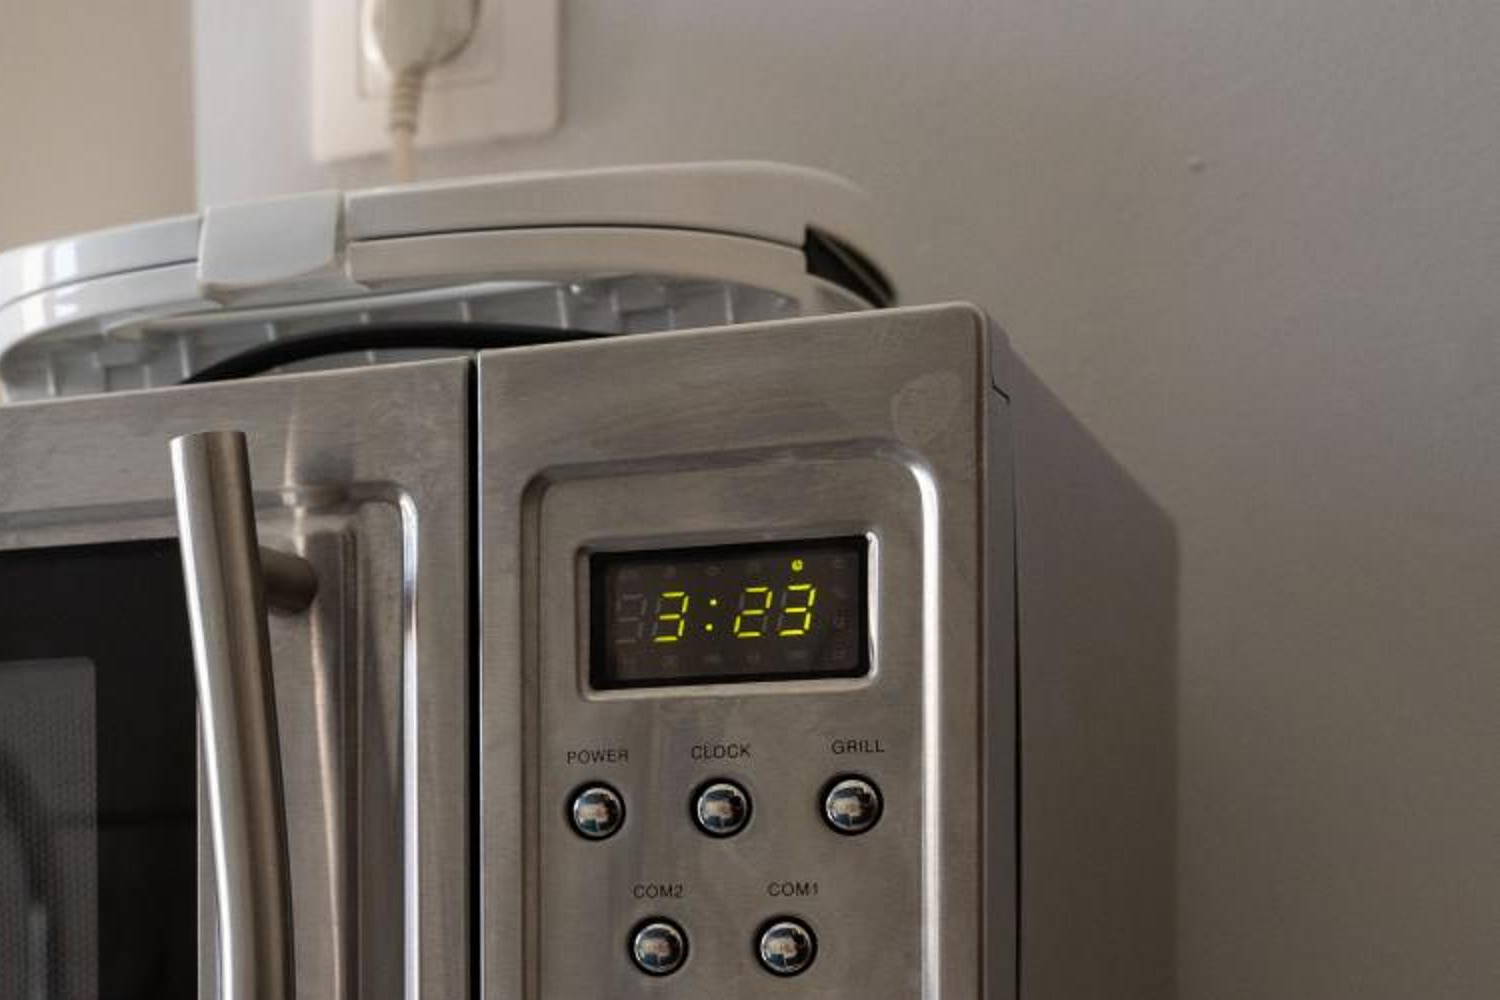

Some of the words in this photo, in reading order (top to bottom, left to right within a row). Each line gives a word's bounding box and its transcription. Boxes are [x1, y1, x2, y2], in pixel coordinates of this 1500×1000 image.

[653, 583, 816, 642] 3:23
[691, 743, 752, 761] CLOCK
[831, 739, 885, 756] GRILL
[566, 748, 629, 765] POWER
[632, 883, 684, 899] COM2
[767, 881, 819, 898] COM1
